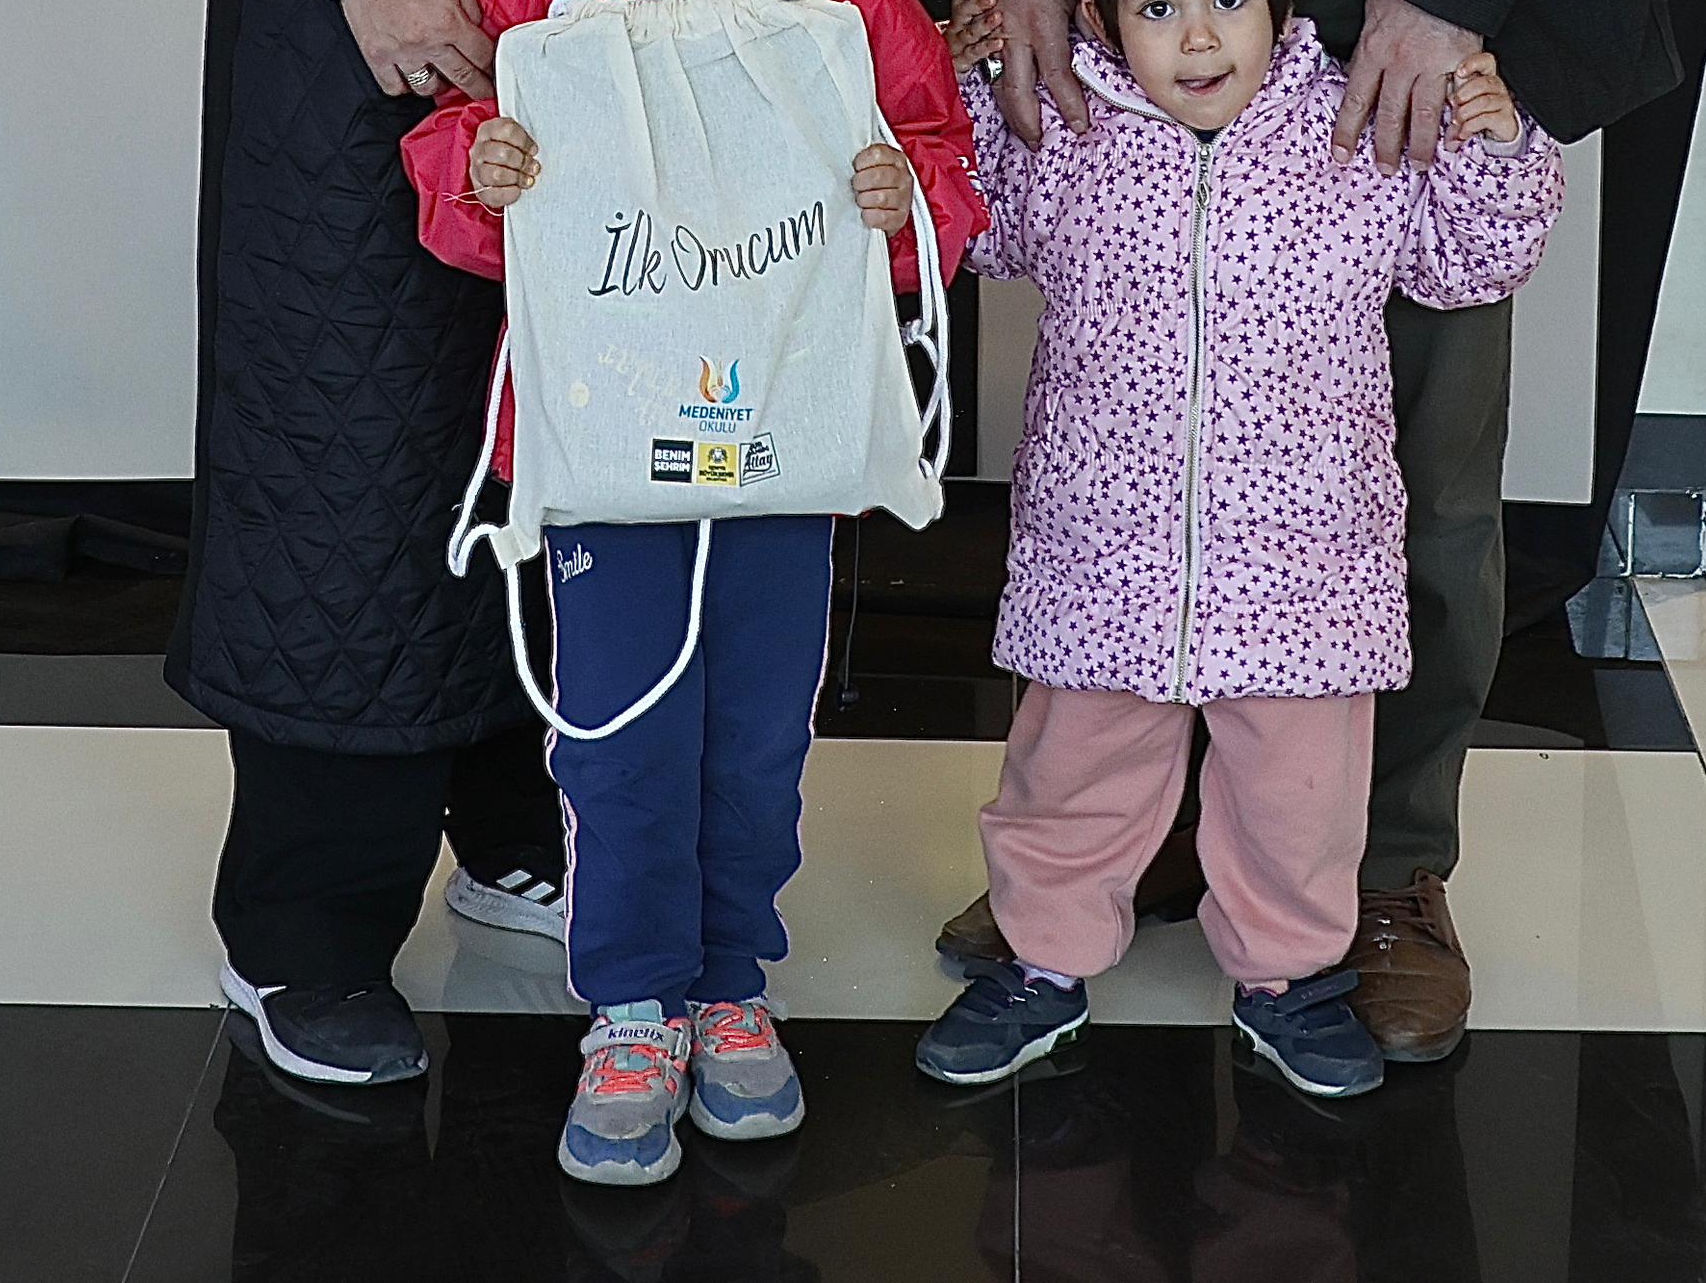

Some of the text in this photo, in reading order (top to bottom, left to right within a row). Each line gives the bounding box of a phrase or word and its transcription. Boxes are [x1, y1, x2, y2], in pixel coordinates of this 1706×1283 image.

[587, 201, 827, 296] İlk Orucum
[678, 403, 754, 421] MEDENİYET
[698, 419, 737, 433] OKULU
[654, 448, 691, 462] BENİM
[608, 1027, 665, 1042] kinetix
